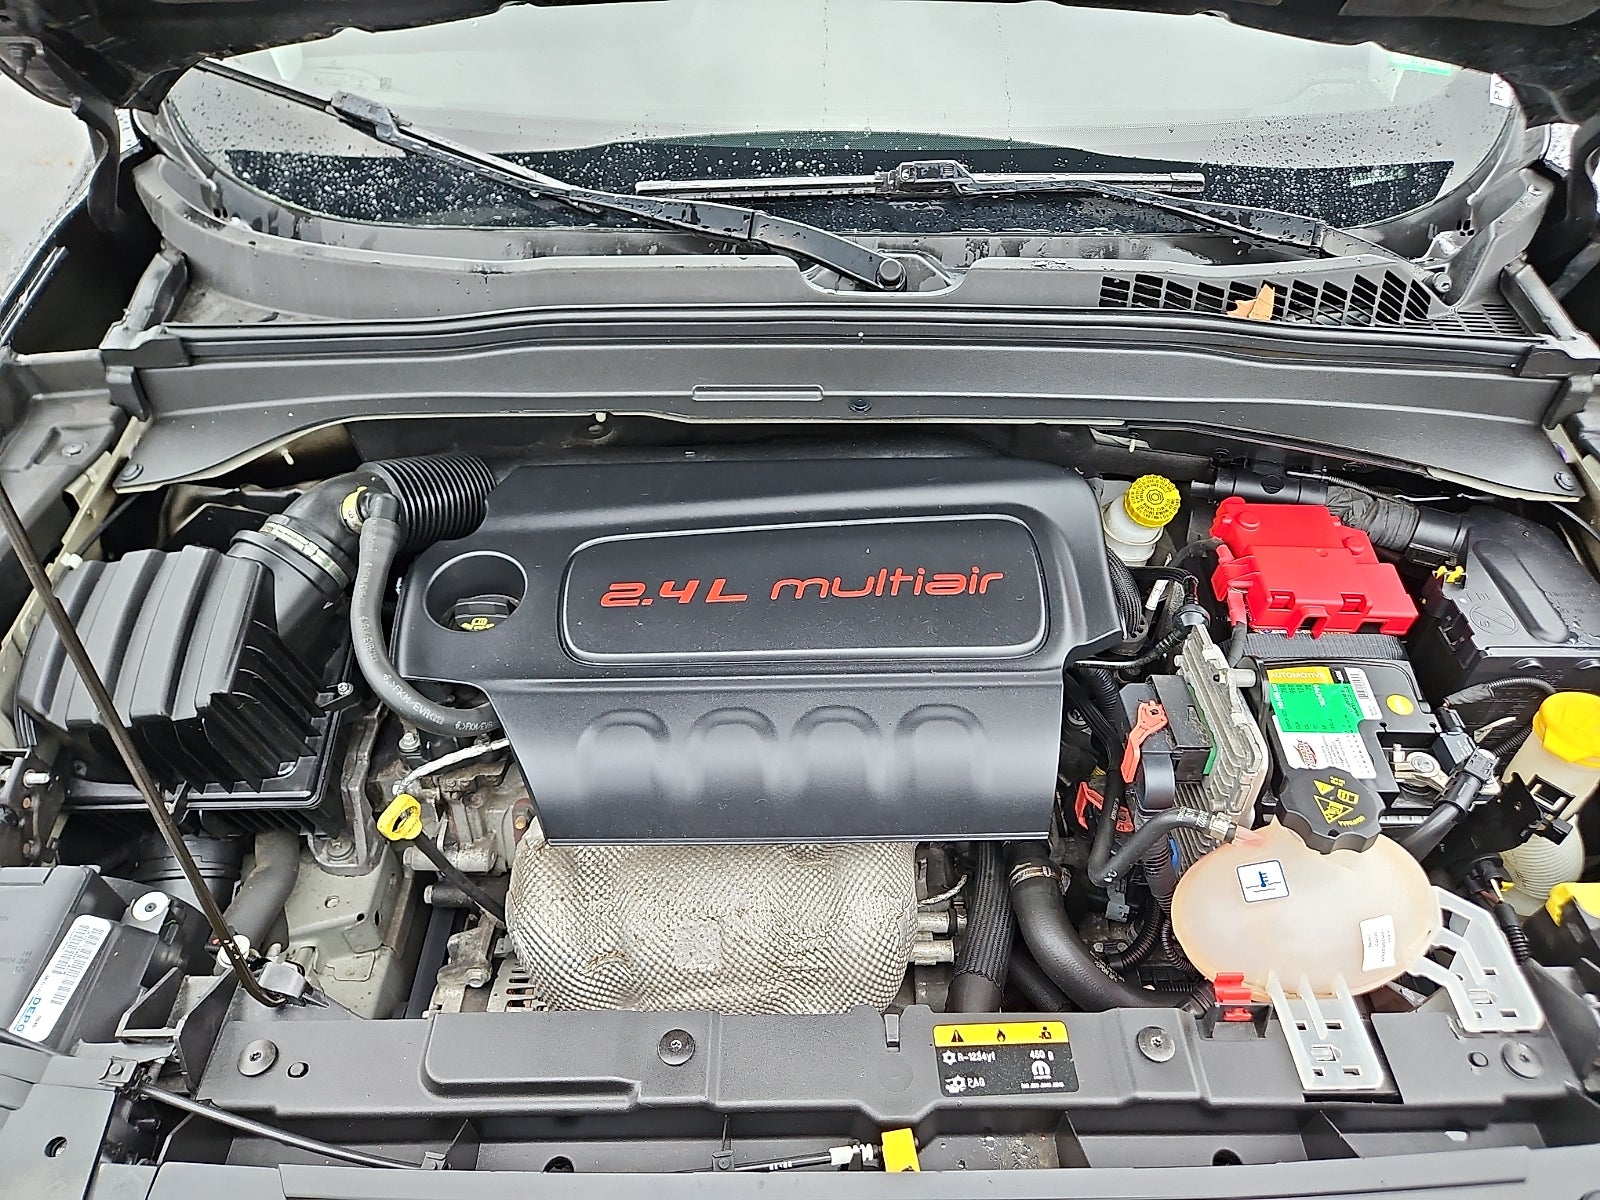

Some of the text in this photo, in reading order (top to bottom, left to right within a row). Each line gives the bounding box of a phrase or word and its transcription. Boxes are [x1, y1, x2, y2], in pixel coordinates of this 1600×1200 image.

[600, 566, 1004, 607] 2.4 L multiair
[1270, 671, 1326, 679] AUTOMOTIVE
[16, 996, 41, 1034] DEPO
